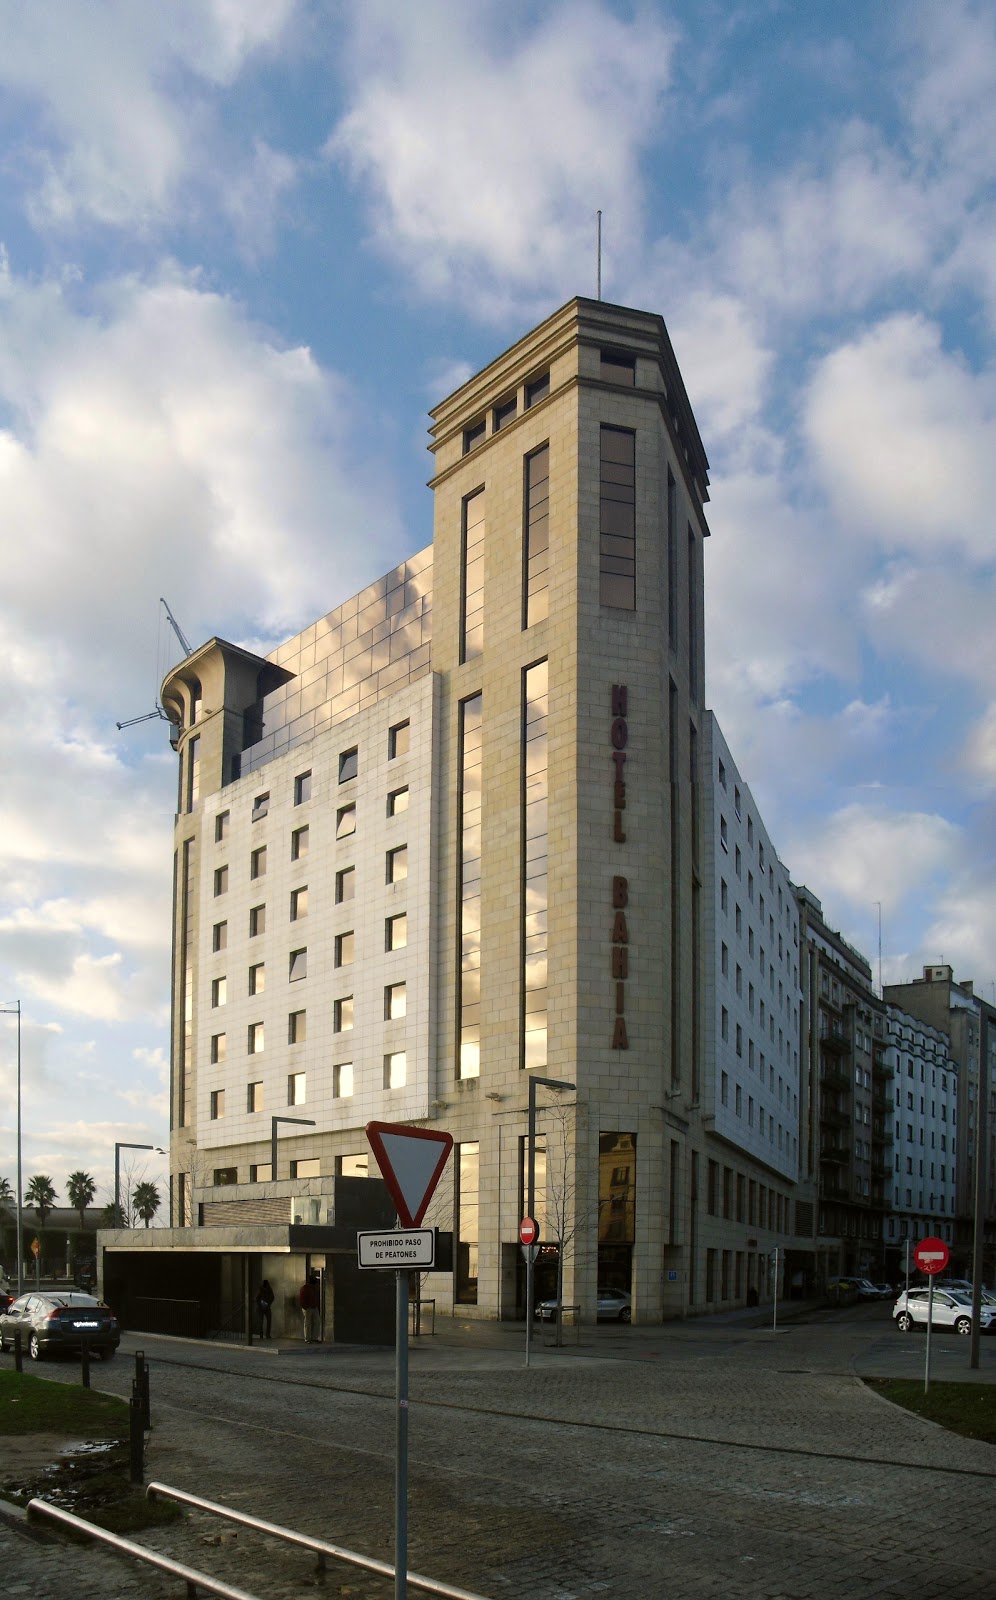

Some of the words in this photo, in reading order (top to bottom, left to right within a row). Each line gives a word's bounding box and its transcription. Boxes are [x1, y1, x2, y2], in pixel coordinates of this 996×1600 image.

[611, 684, 628, 843] HOTEL
[612, 875, 629, 1050] BAHIA
[370, 1239, 403, 1247] PROHIBIDO
[405, 1238, 421, 1246] PASO
